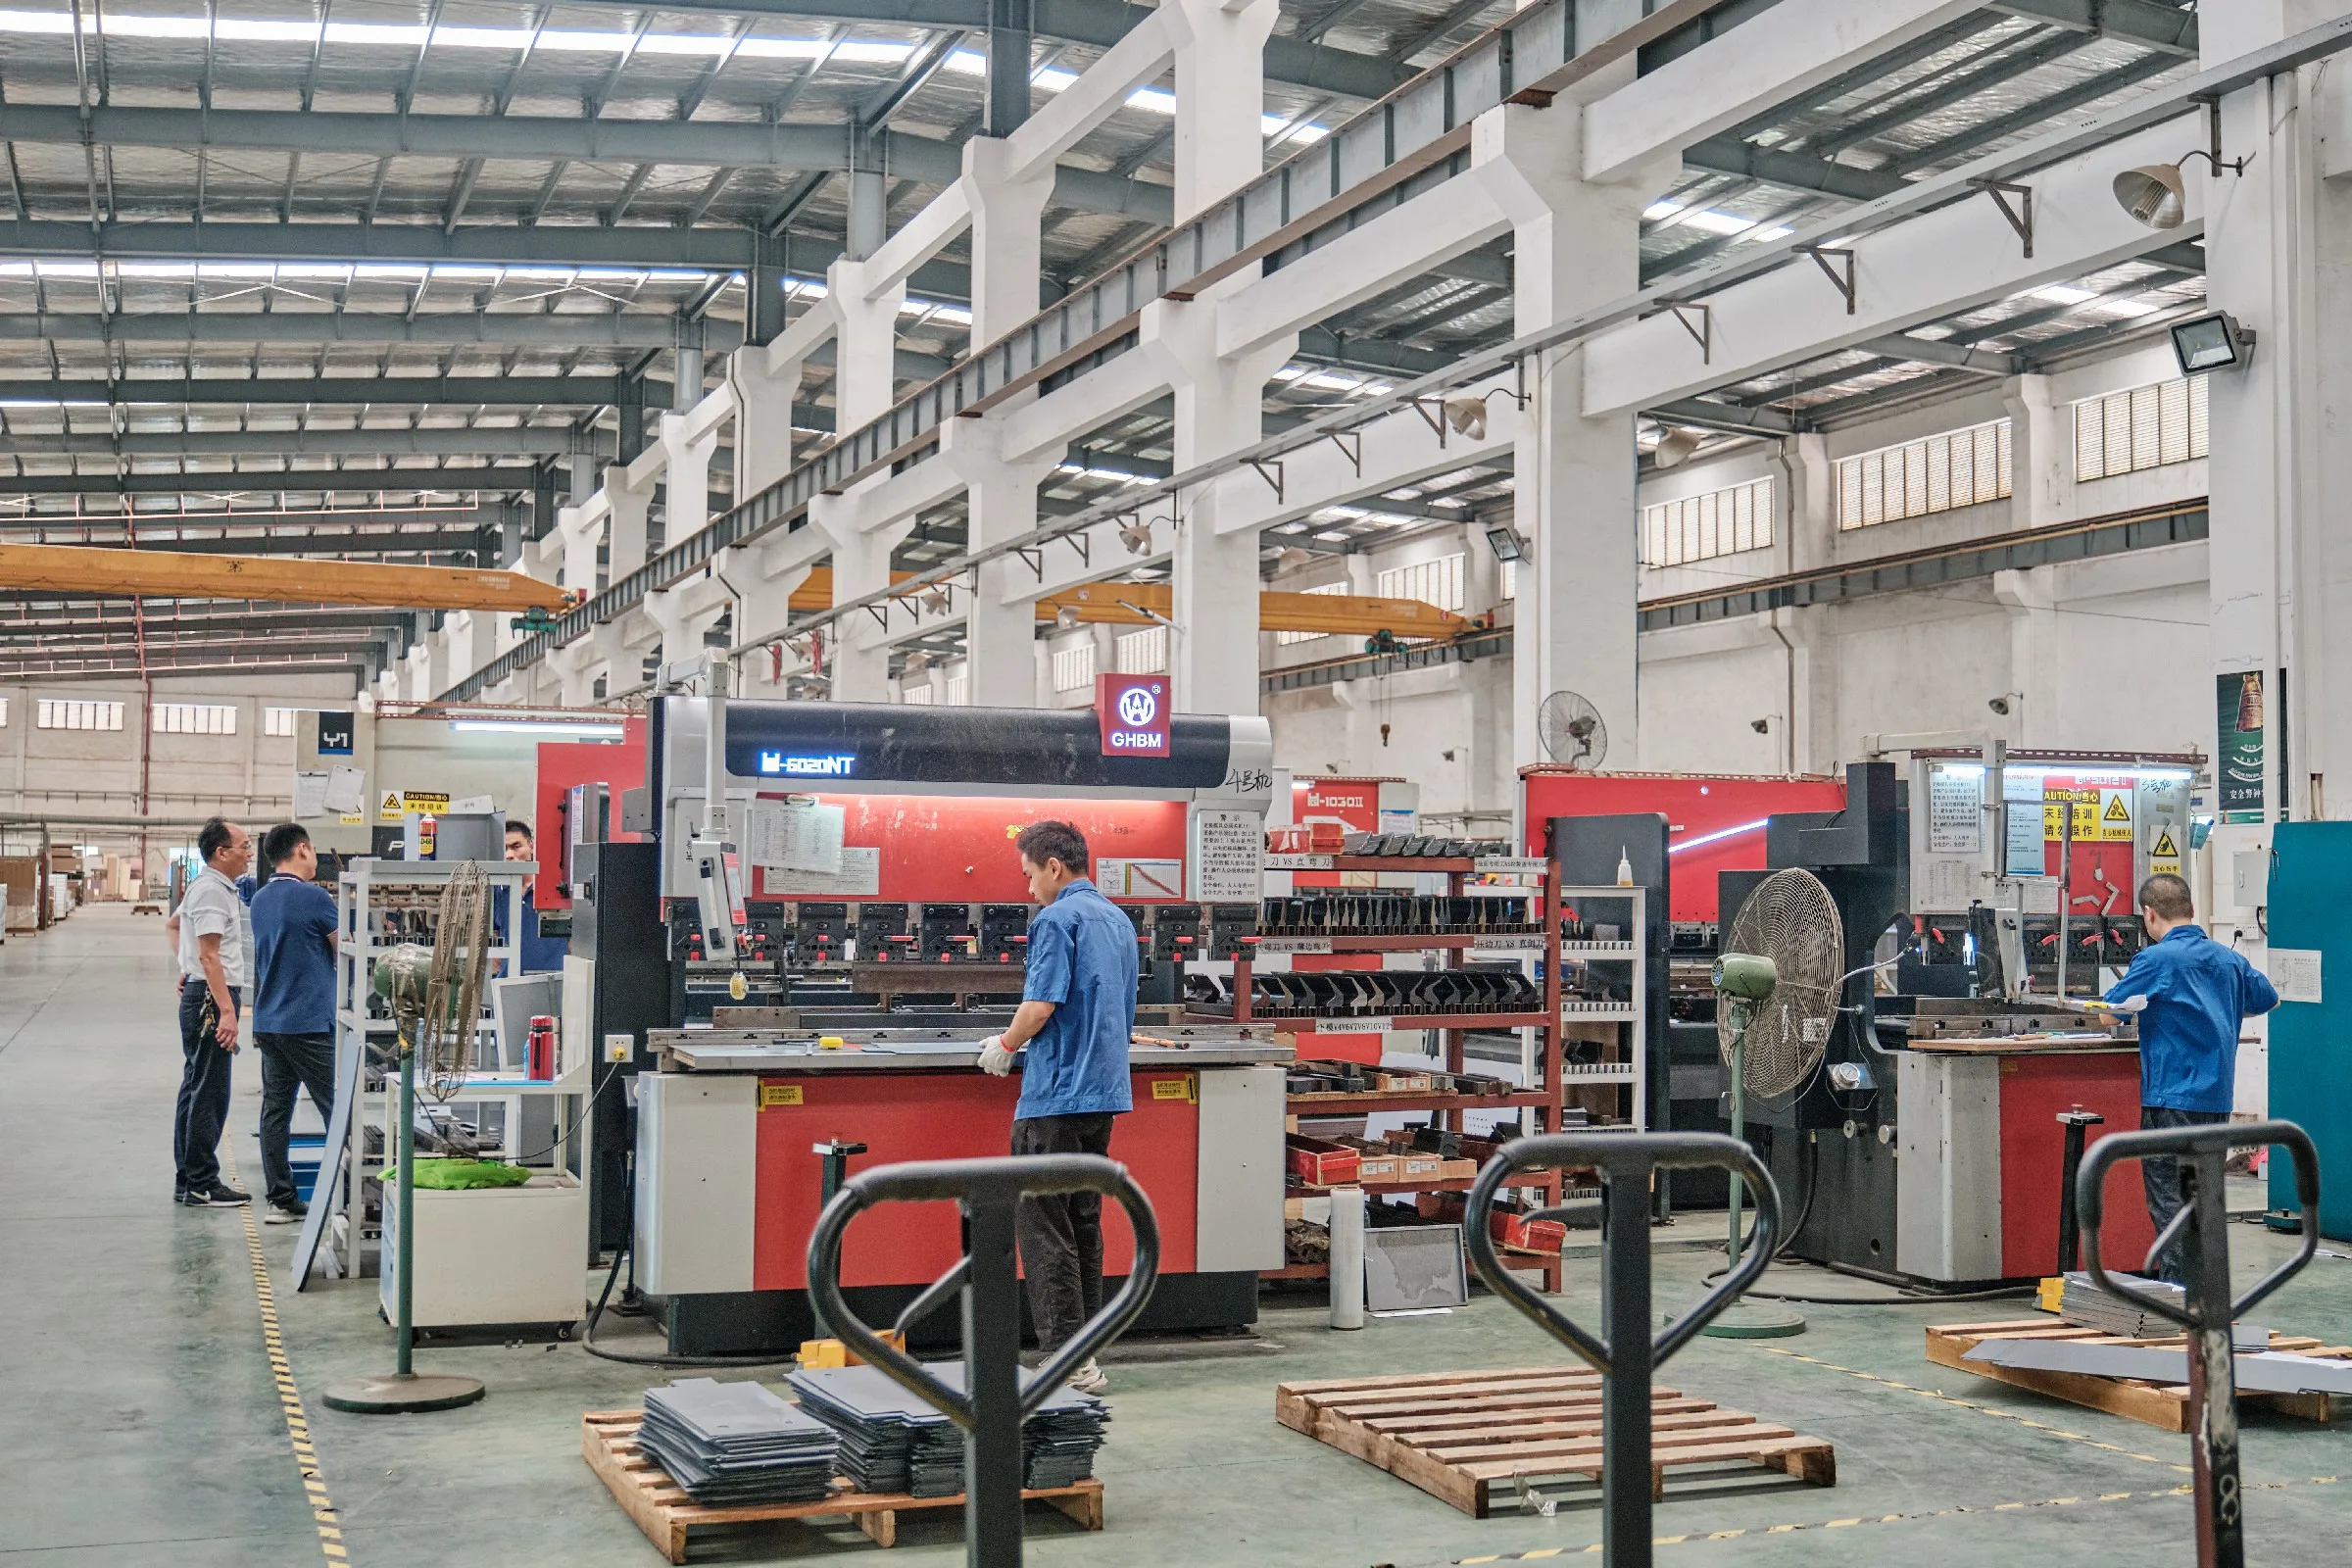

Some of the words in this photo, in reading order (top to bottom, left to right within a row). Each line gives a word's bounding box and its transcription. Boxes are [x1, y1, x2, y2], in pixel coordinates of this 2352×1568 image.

[1111, 732, 1162, 748] GHBM
[2230, 788, 2264, 800] 安全警钟
